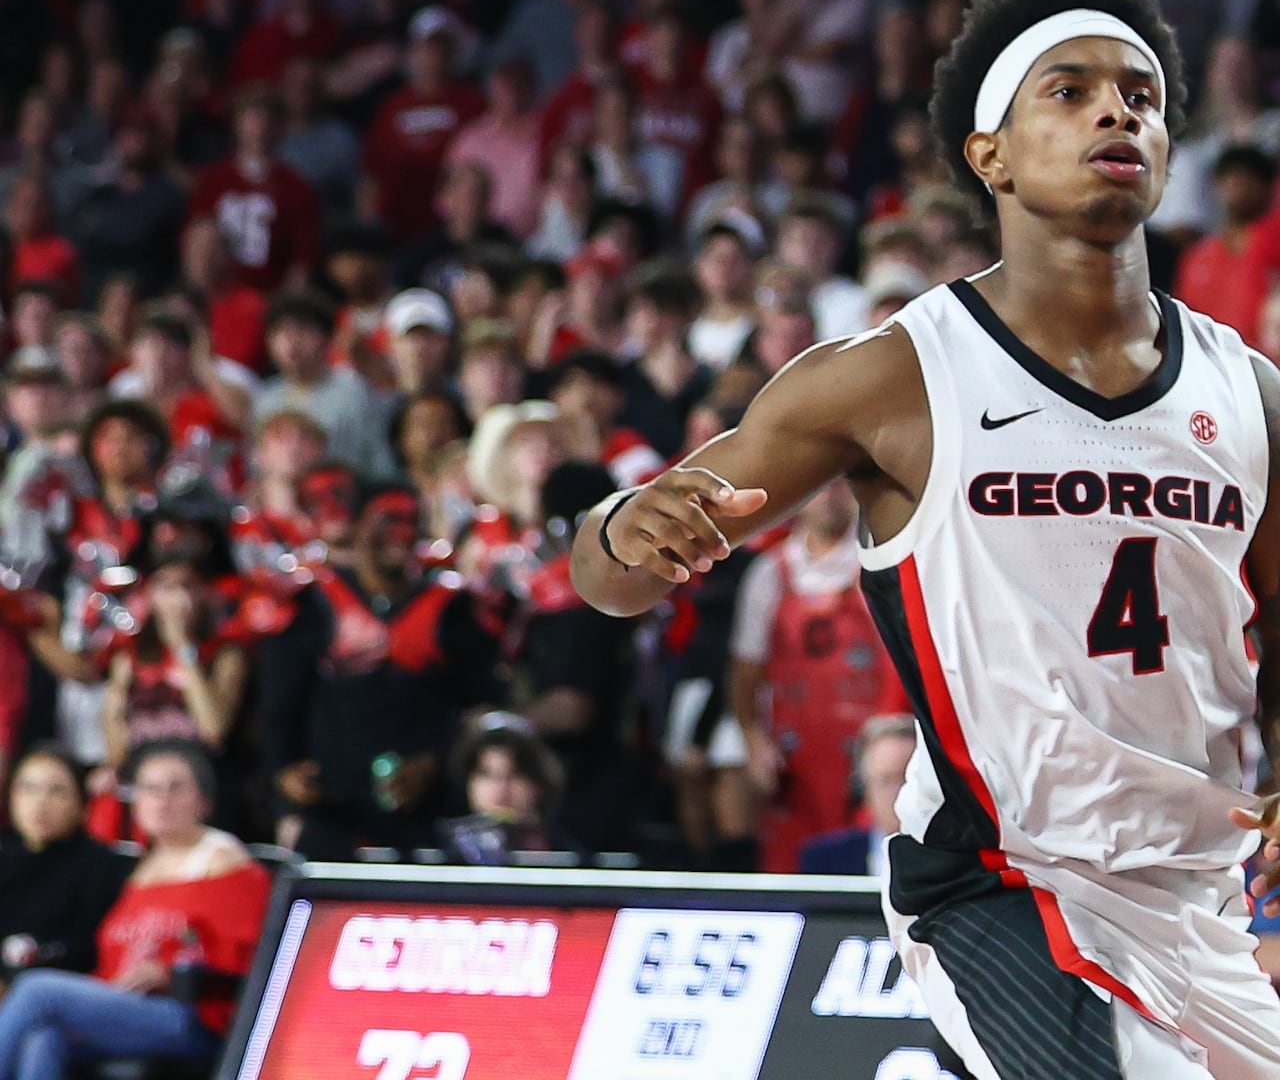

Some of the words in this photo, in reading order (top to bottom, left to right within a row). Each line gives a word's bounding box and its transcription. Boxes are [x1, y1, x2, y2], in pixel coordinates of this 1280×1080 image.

[1193, 414, 1216, 441] SEC
[967, 470, 1245, 532] GEORGIA
[1087, 536, 1170, 676] 4
[329, 916, 558, 996] GEORGIA
